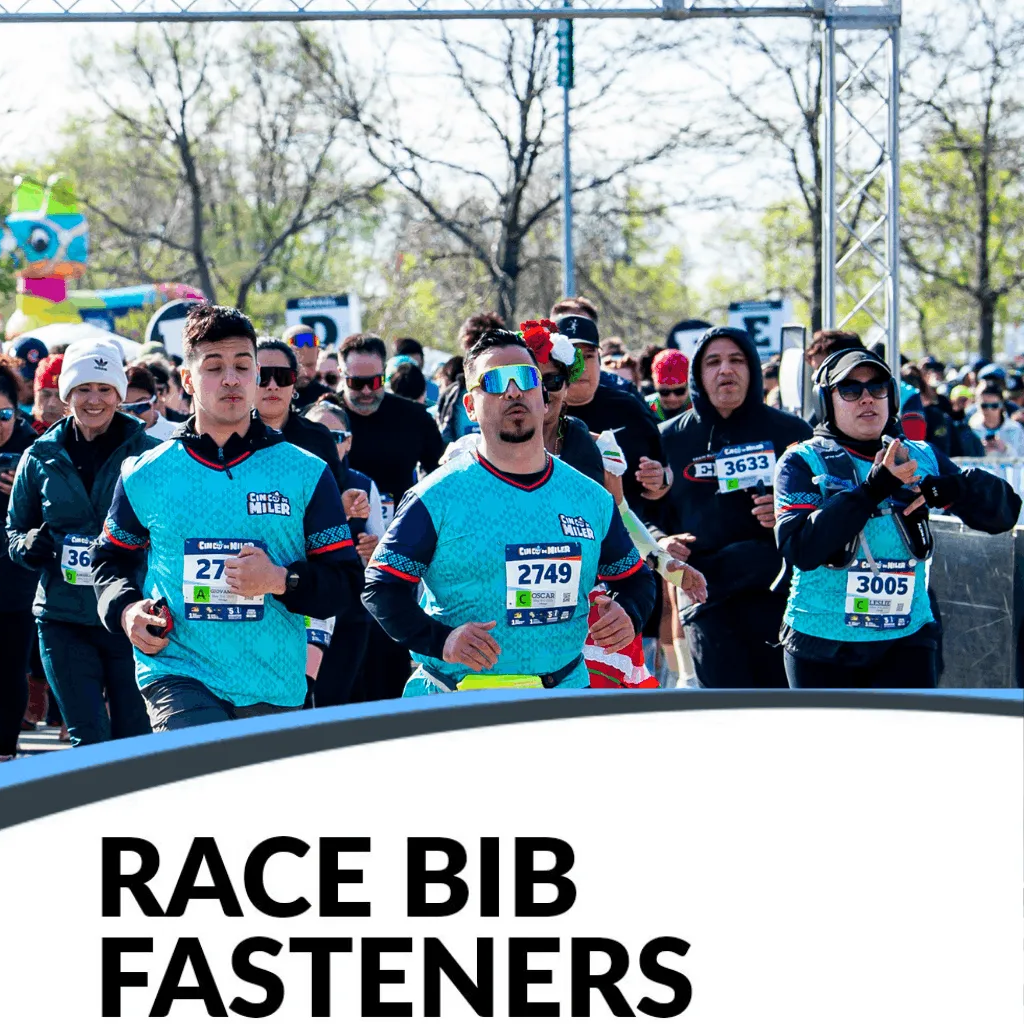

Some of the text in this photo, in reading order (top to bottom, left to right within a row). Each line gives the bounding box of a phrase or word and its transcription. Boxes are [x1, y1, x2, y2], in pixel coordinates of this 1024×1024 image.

[743, 316, 771, 346] E
[724, 455, 769, 476] 3633
[247, 491, 280, 503] CINCO
[248, 501, 292, 516] MILER
[68, 549, 91, 567] 36
[196, 558, 226, 580] 27
[517, 562, 572, 585] 2749
[196, 588, 206, 600] A
[855, 575, 908, 595] 3005
[519, 593, 527, 605] C
[856, 600, 864, 610] C
